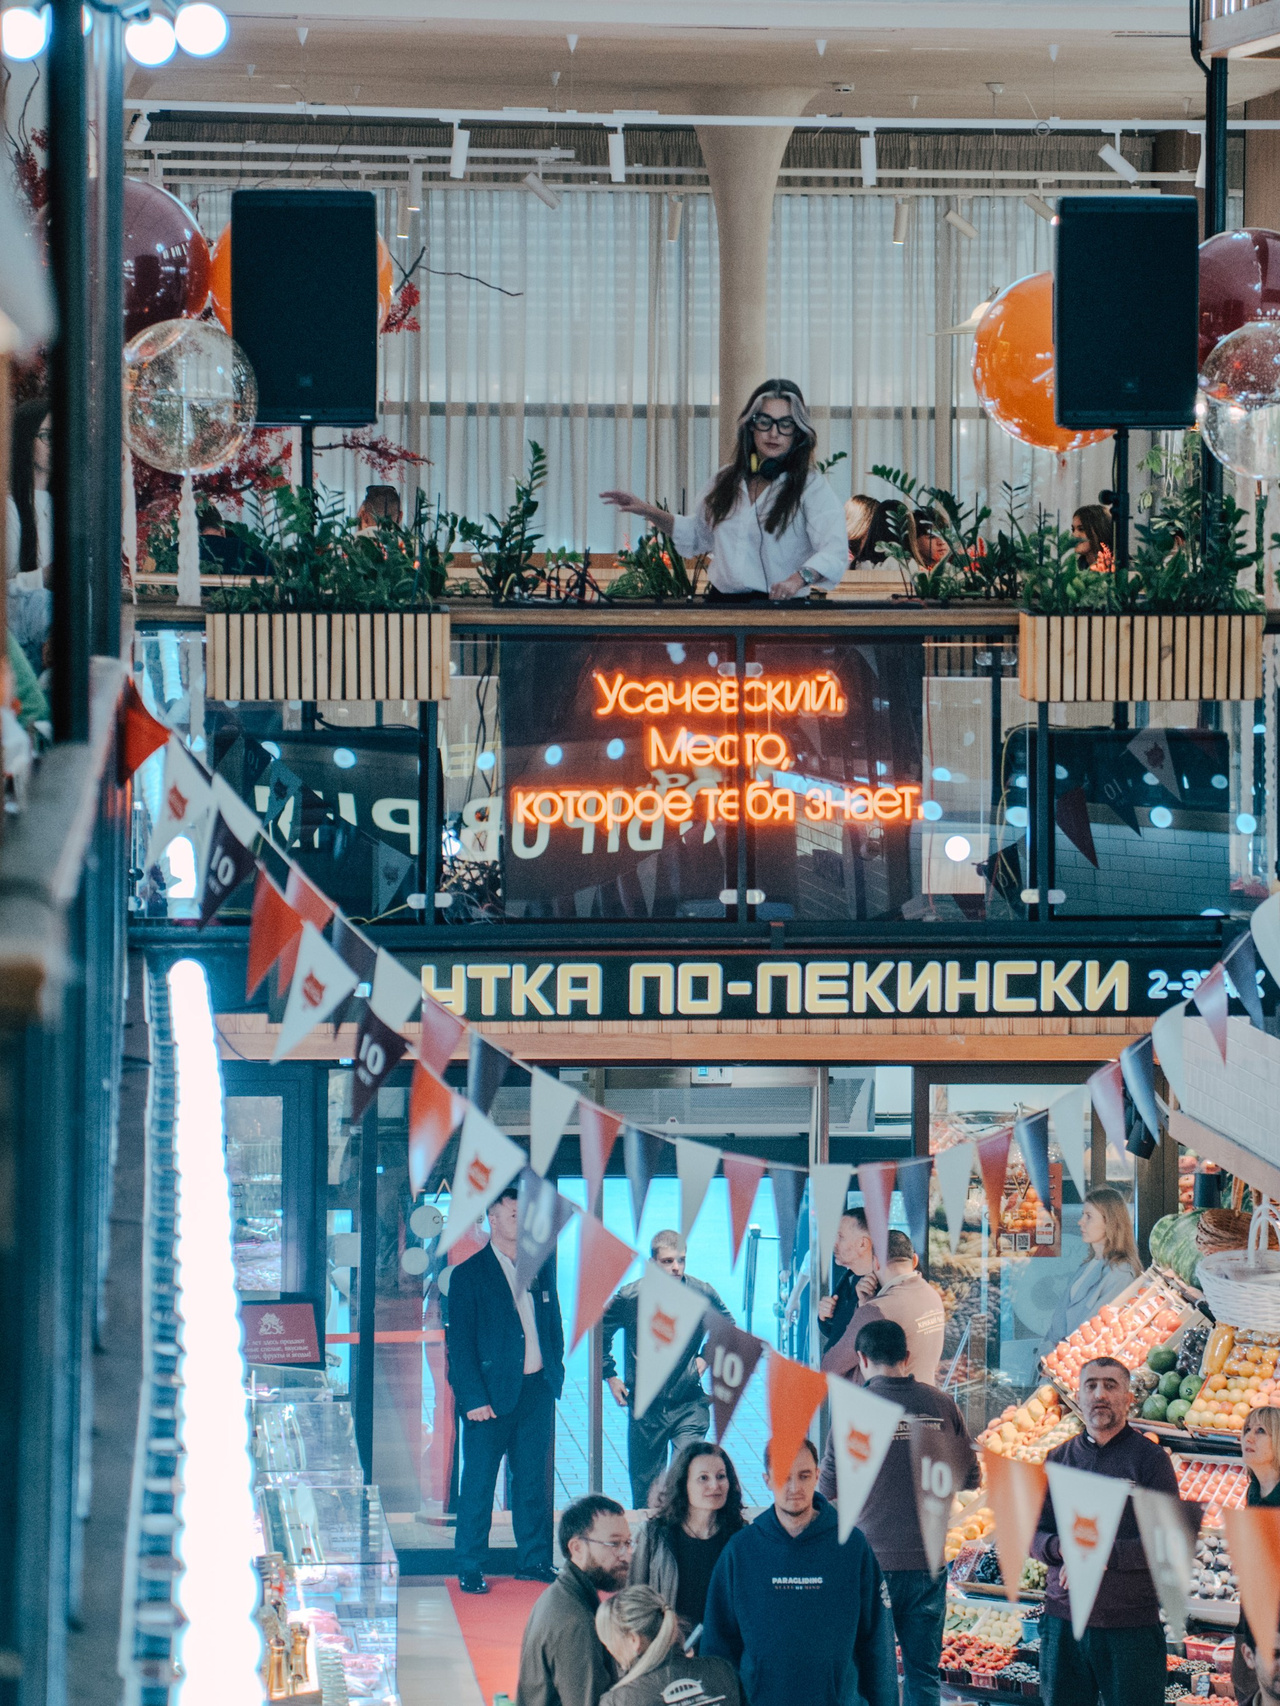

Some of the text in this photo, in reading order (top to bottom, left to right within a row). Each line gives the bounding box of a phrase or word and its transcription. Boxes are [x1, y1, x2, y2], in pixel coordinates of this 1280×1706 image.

[516, 790, 693, 831] которое
[700, 781, 796, 820] тебя
[210, 845, 236, 887] 10
[421, 963, 602, 1016] УТКА
[629, 961, 1129, 1015] ПО-ПЕКИНСКИ
[359, 1033, 386, 1076] 10
[712, 1346, 744, 1388] 10
[921, 1458, 952, 1499] 10
[771, 1577, 823, 1585] PARAGLIDING
